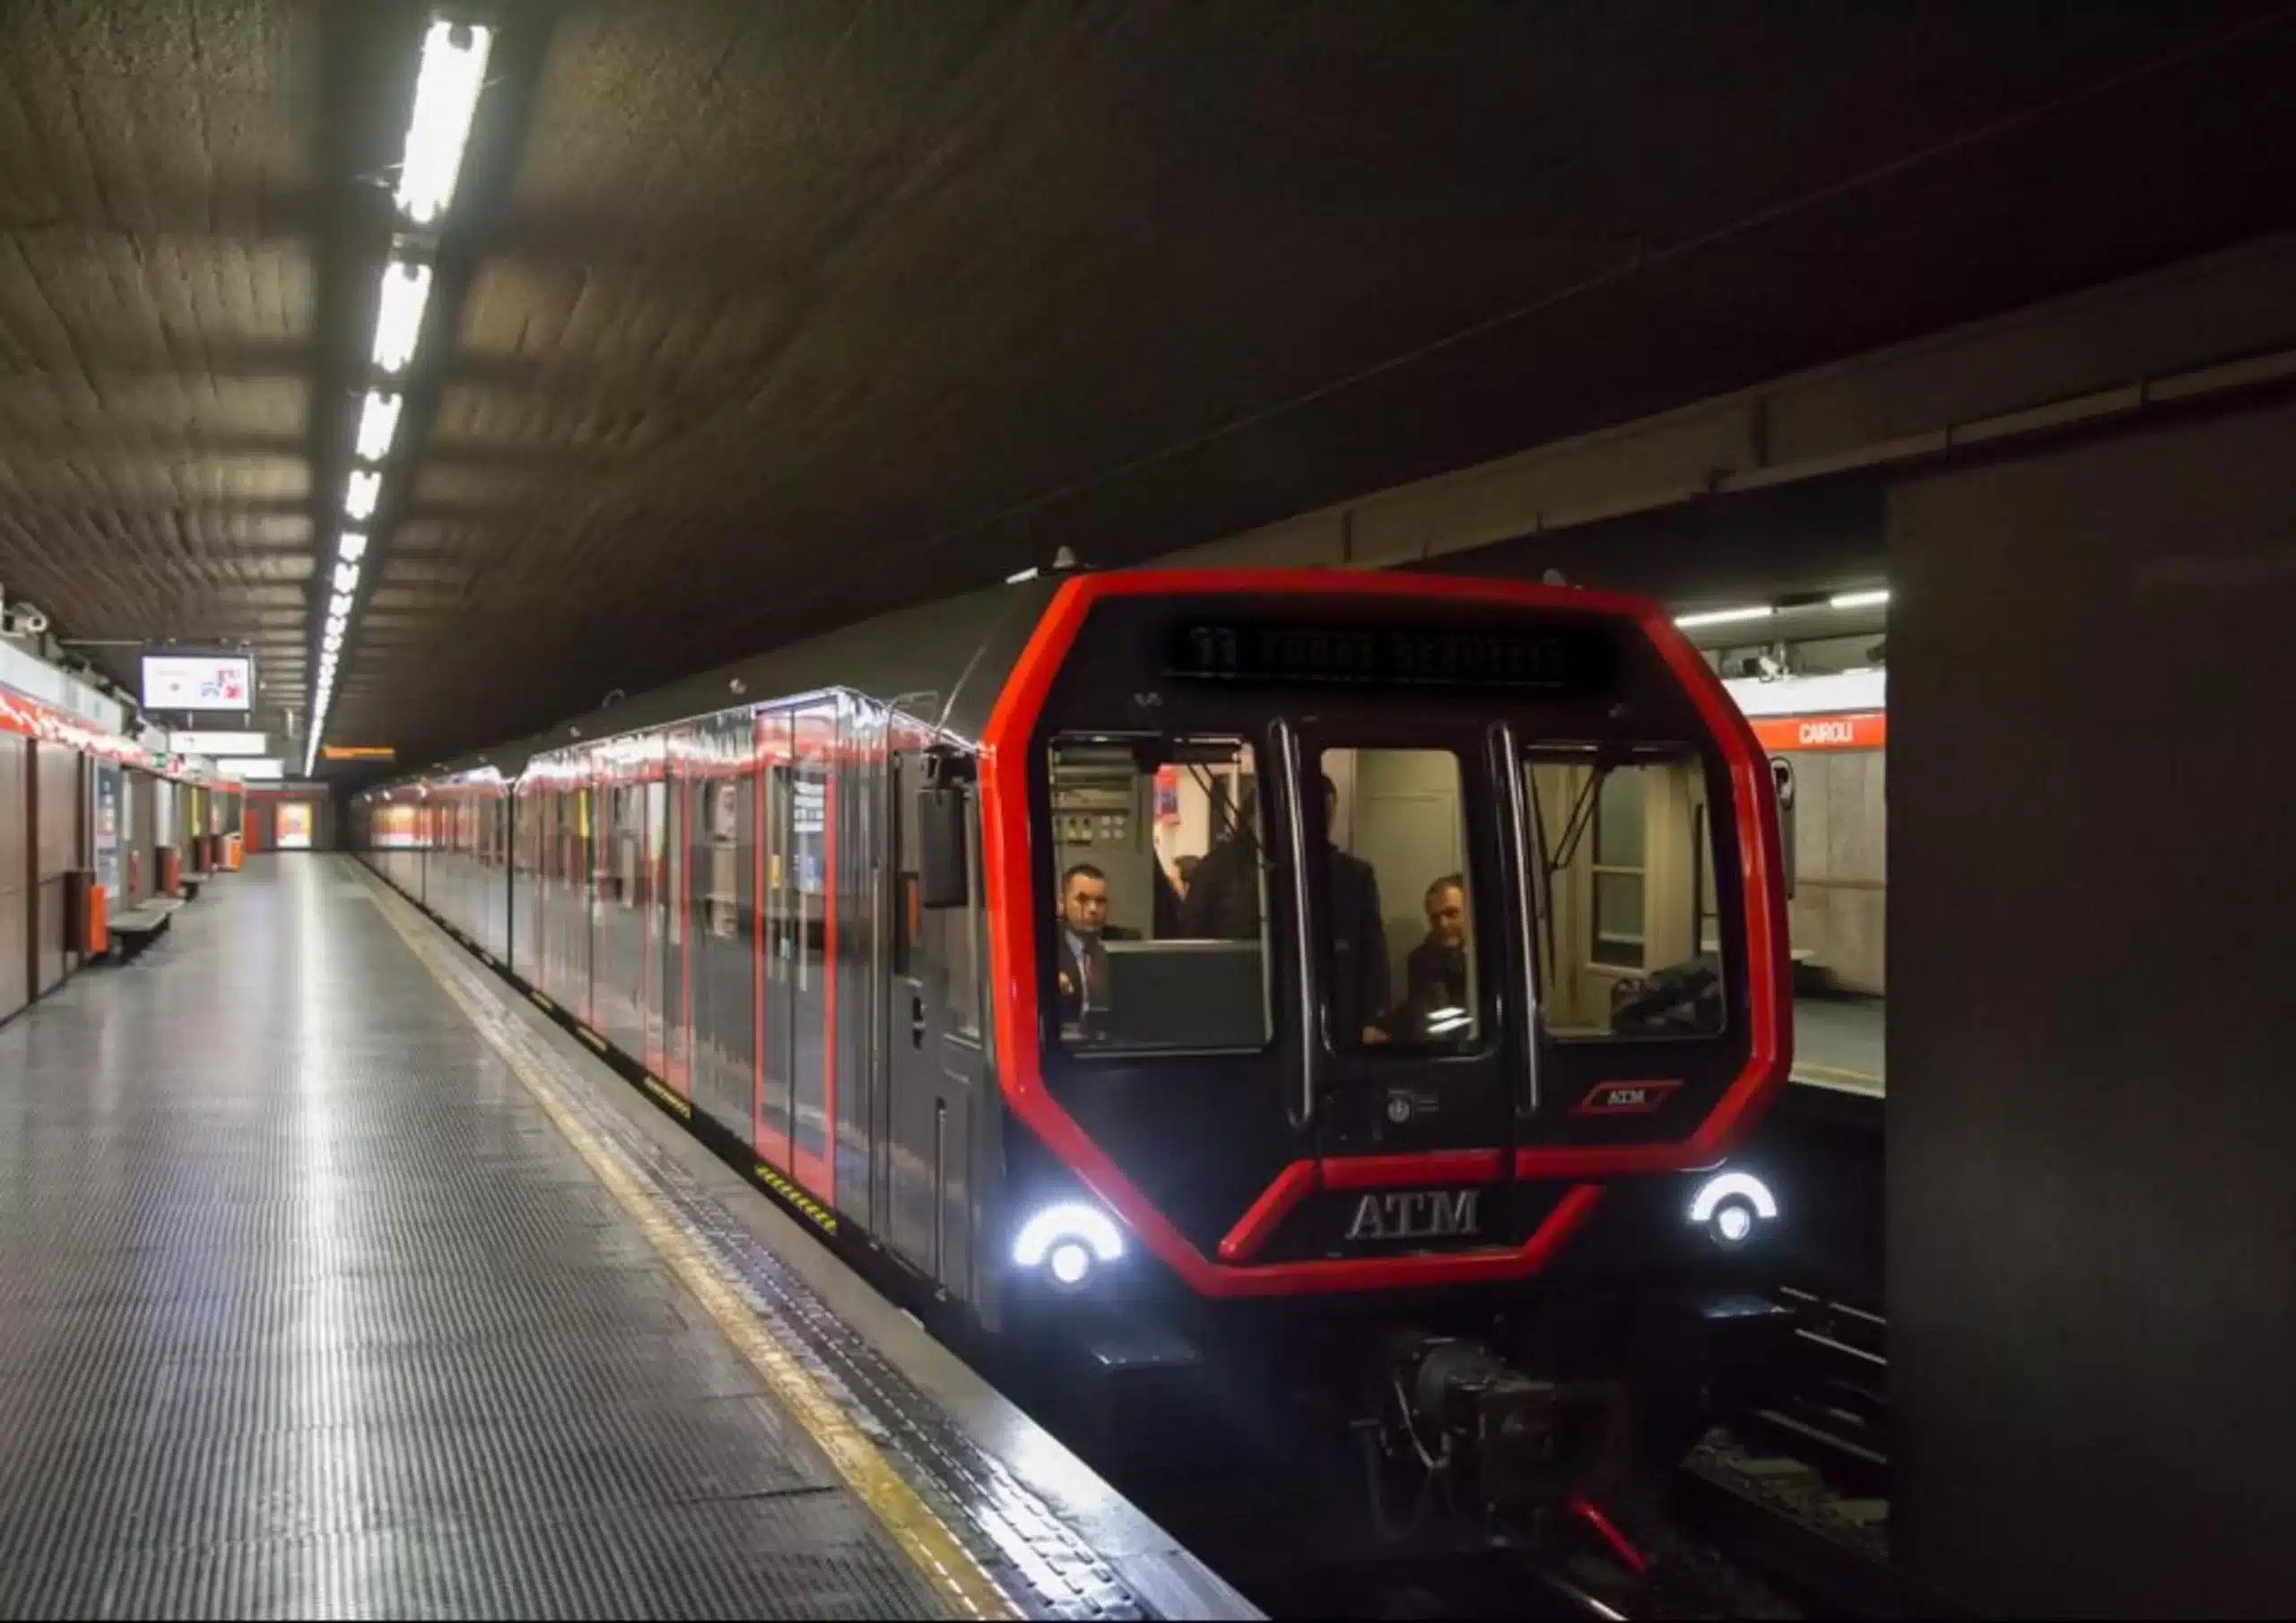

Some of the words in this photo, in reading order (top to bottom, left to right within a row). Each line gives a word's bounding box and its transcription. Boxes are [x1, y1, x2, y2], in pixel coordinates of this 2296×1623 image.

[1799, 720, 1854, 743] CAIROLI
[1607, 1089, 1646, 1105] ATM
[1346, 1191, 1481, 1240] ATM
